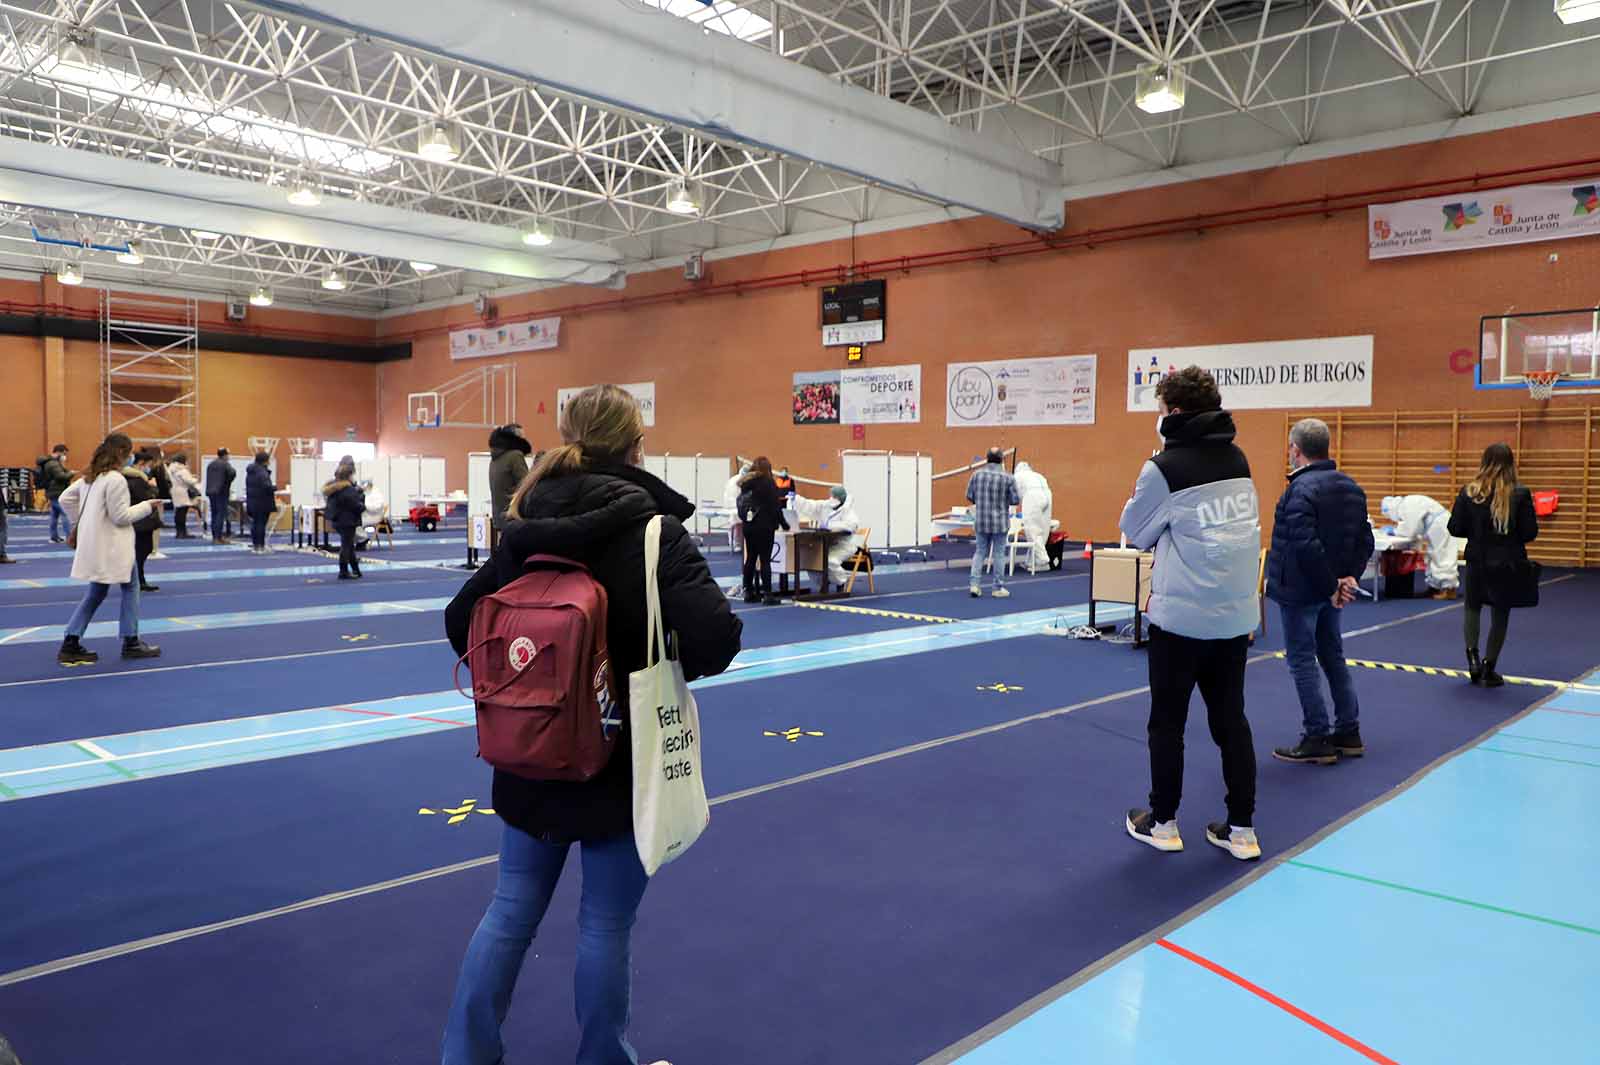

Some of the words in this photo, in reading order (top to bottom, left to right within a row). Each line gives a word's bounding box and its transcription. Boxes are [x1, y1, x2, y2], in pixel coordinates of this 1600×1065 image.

[1516, 213, 1544, 225] Junta
[1547, 211, 1560, 221] de
[1393, 228, 1420, 239] Junta
[1422, 227, 1432, 236] de
[1488, 222, 1523, 236] Castilla
[1526, 223, 1533, 234] y
[1534, 220, 1560, 232] León
[1369, 237, 1399, 249] Castilla
[1408, 235, 1432, 245] León
[1449, 348, 1474, 374] C
[1207, 364, 1276, 386] VERSIDAD
[1280, 363, 1299, 384] DE
[1303, 360, 1366, 383] BURGOS
[870, 381, 914, 393] DEPORTE
[537, 401, 545, 414] A
[852, 424, 865, 440] B
[476, 523, 483, 542] 3
[768, 542, 781, 563] 2
[656, 704, 682, 729] Fett
